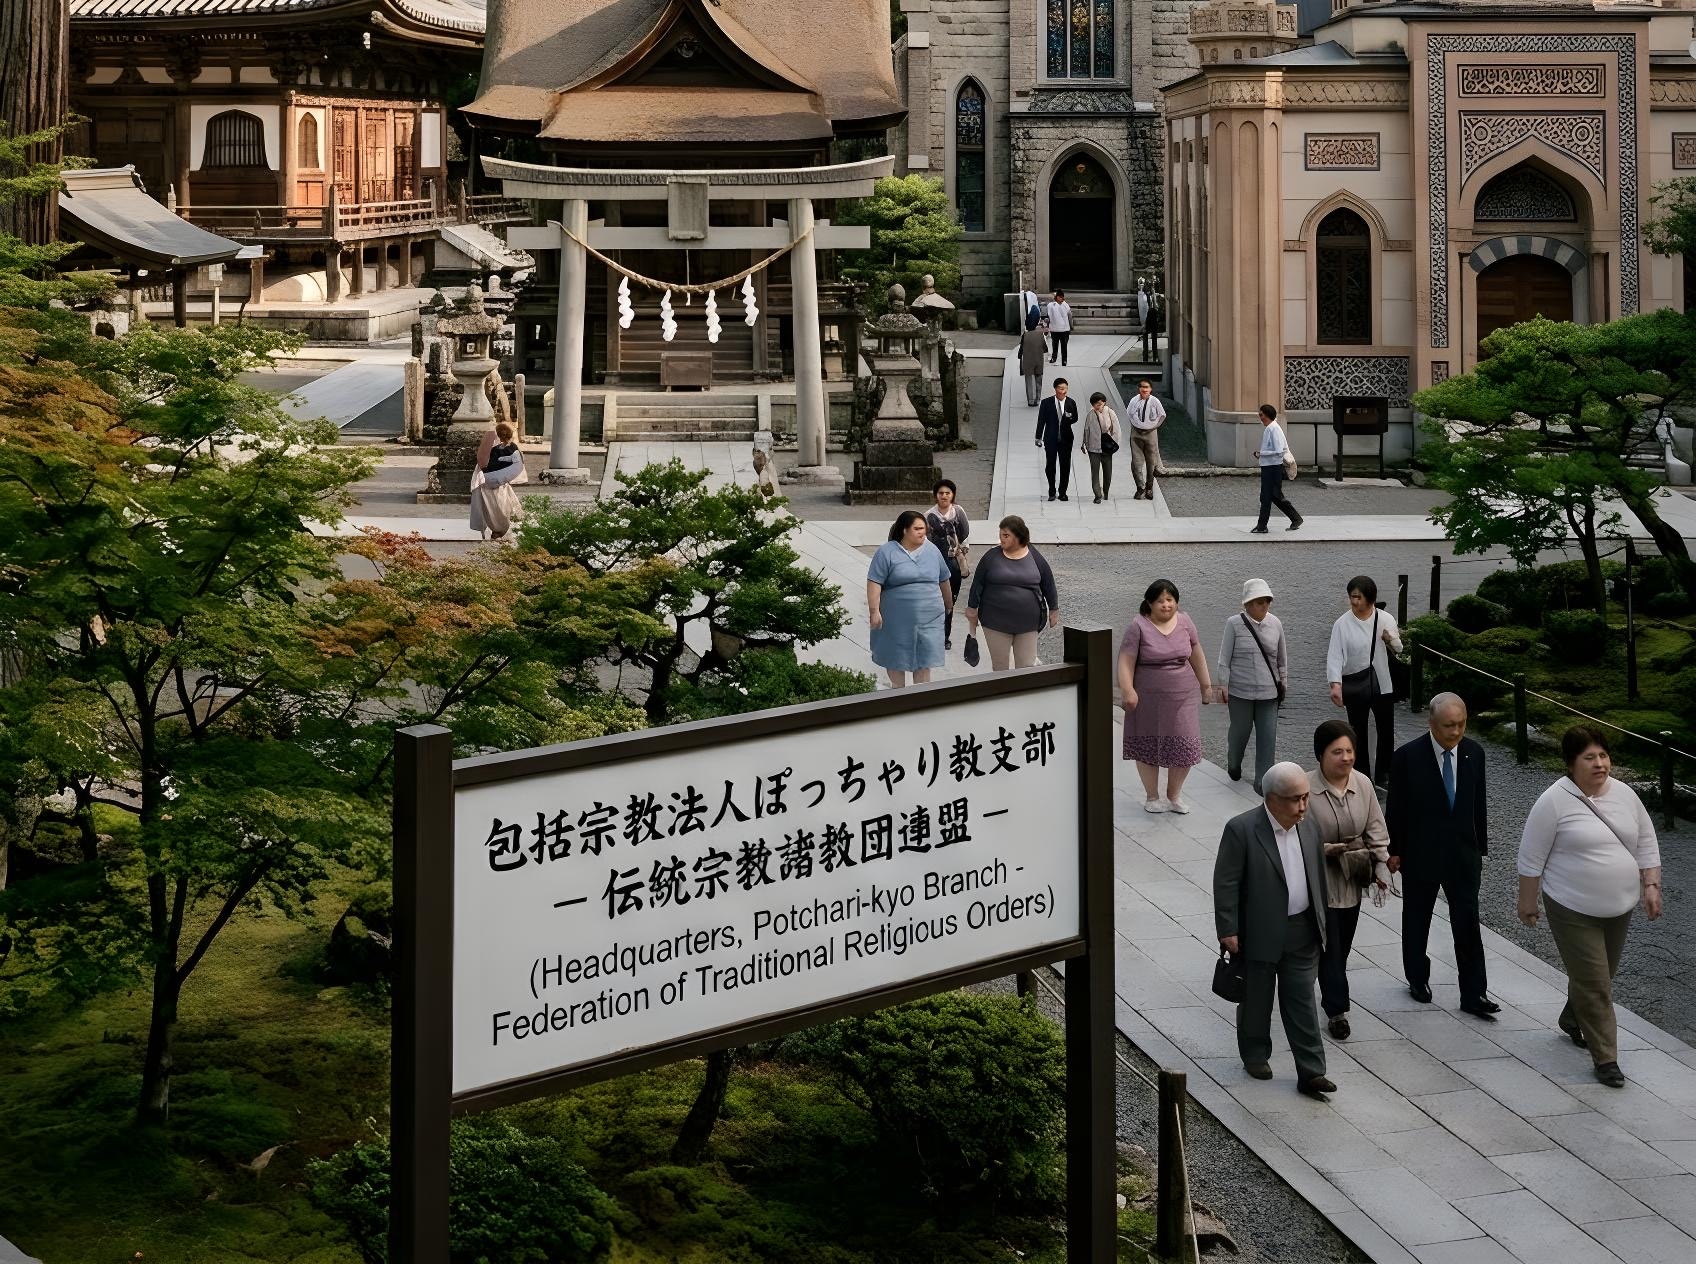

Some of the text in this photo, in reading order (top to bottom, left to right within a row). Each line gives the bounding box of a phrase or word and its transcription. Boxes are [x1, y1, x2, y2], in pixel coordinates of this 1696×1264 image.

[484, 721, 1056, 872] 包括宗教法人ぽっちゃり教支部
[492, 987, 649, 1046] Federation
[660, 970, 688, 1006] of
[695, 936, 834, 996] Traditional
[966, 884, 1055, 930] Orders)
[530, 925, 742, 1000] (Headquarters,
[754, 884, 915, 941] Potchari-kyo
[923, 857, 1007, 901] Branch
